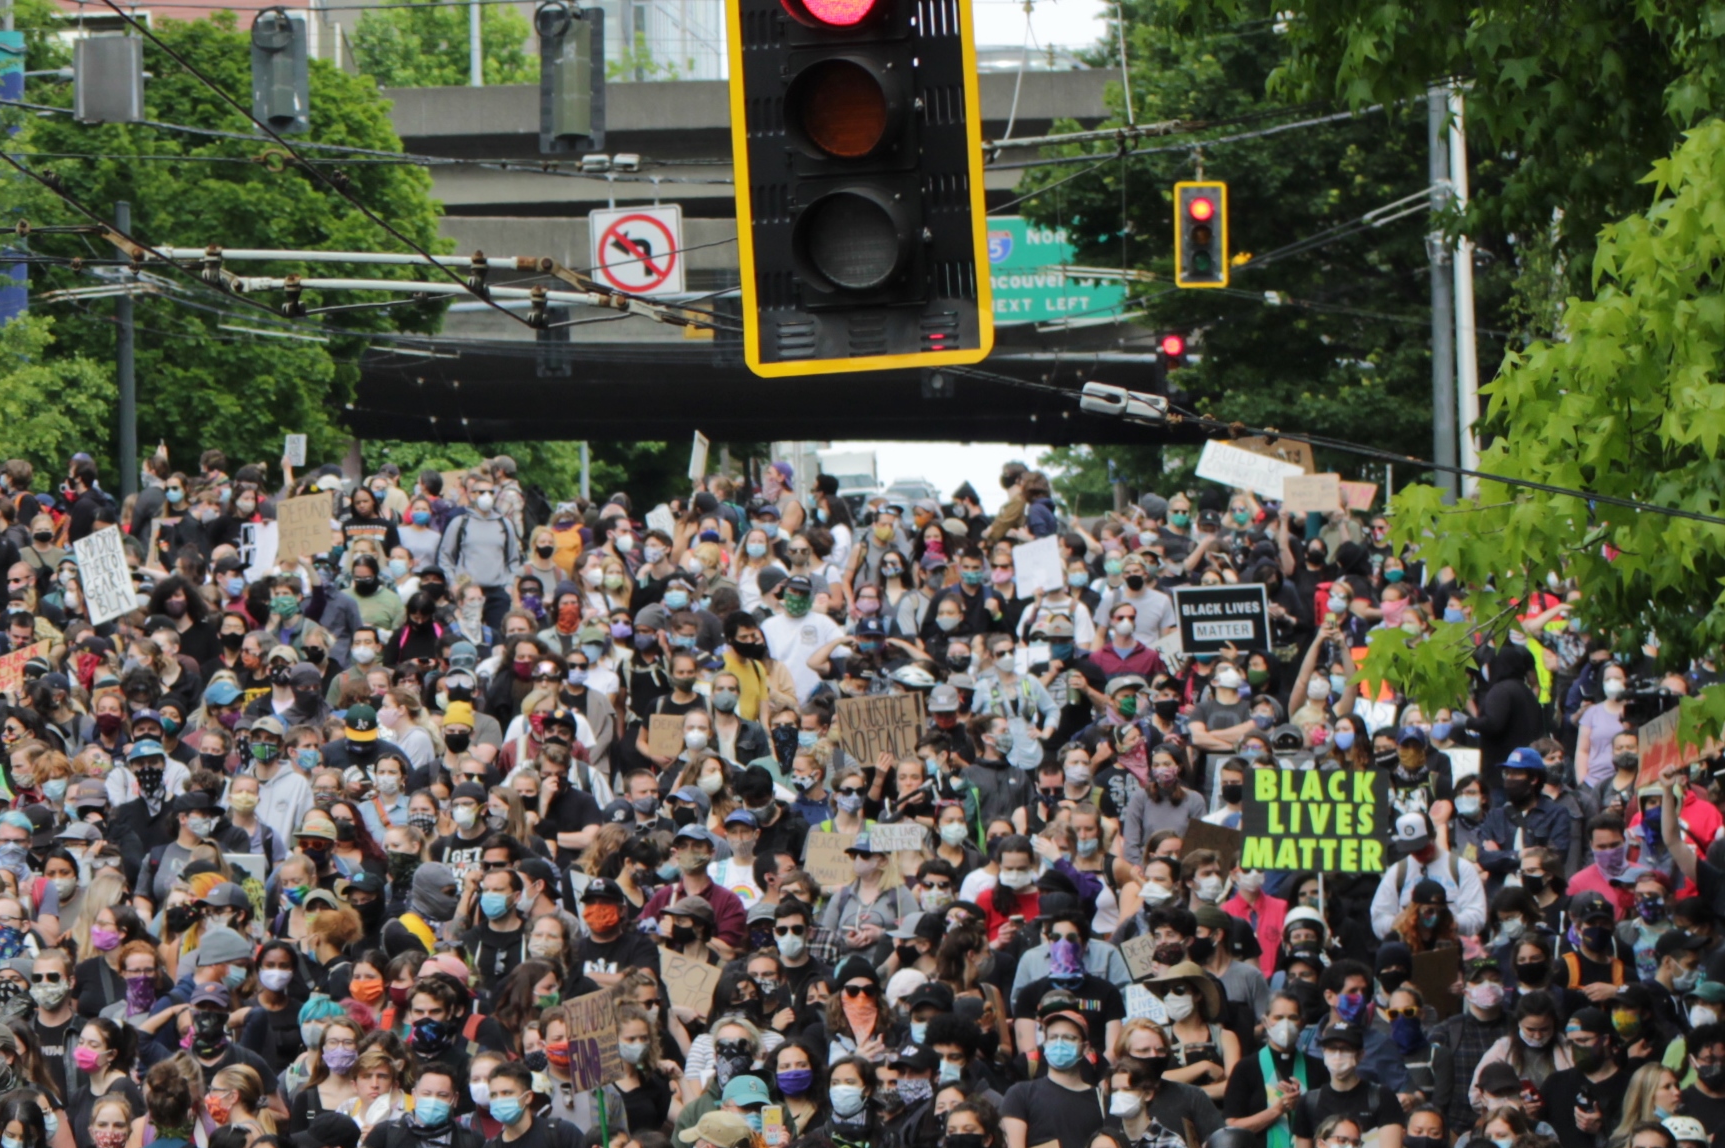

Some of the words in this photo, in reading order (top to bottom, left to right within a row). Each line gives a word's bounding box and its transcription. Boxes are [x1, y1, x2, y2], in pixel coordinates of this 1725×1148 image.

[1026, 229, 1068, 245] NOR
[1045, 296, 1090, 311] LEFT
[1182, 604, 1223, 616] BLACK
[1225, 601, 1261, 614] LIVES
[1196, 624, 1250, 637] MATTER
[838, 703, 861, 734] NO
[840, 733, 869, 765] NO
[1254, 767, 1377, 804] BLACK
[1267, 801, 1375, 836] LIVES
[1240, 835, 1384, 873] MATTER
